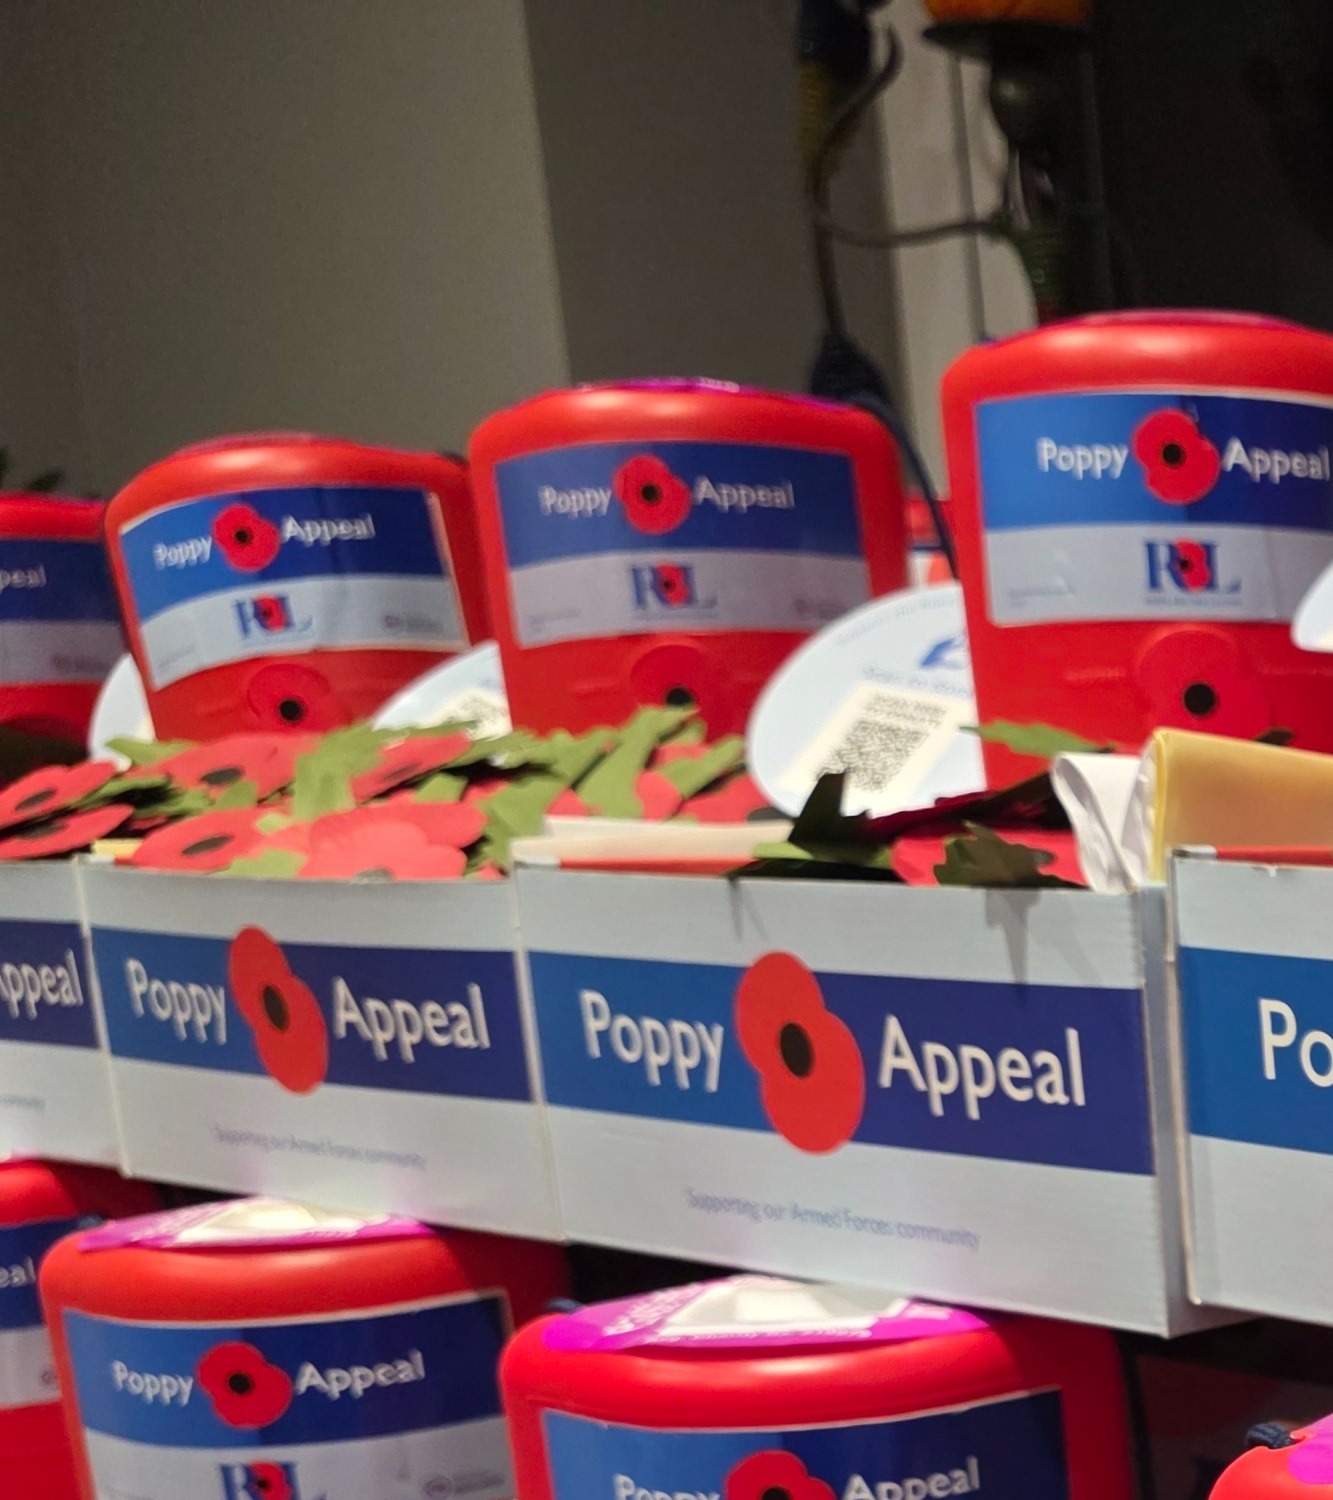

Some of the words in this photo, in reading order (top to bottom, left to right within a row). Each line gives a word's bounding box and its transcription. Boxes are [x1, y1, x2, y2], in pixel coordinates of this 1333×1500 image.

[1035, 436, 1129, 480] Poppy
[1222, 436, 1331, 484] Appeal
[540, 485, 612, 517] Poppy
[690, 477, 796, 508] Appeal
[153, 536, 214, 570] Poppy
[280, 514, 376, 543] Appeal
[0, 947, 84, 1020] ppeal
[125, 956, 227, 1046] Poppy
[332, 975, 492, 1065] Appeal
[579, 987, 725, 1094] Poppy
[879, 1013, 1087, 1122] Appeal
[112, 1358, 195, 1407] Poppy
[297, 1348, 427, 1400] Appeal
